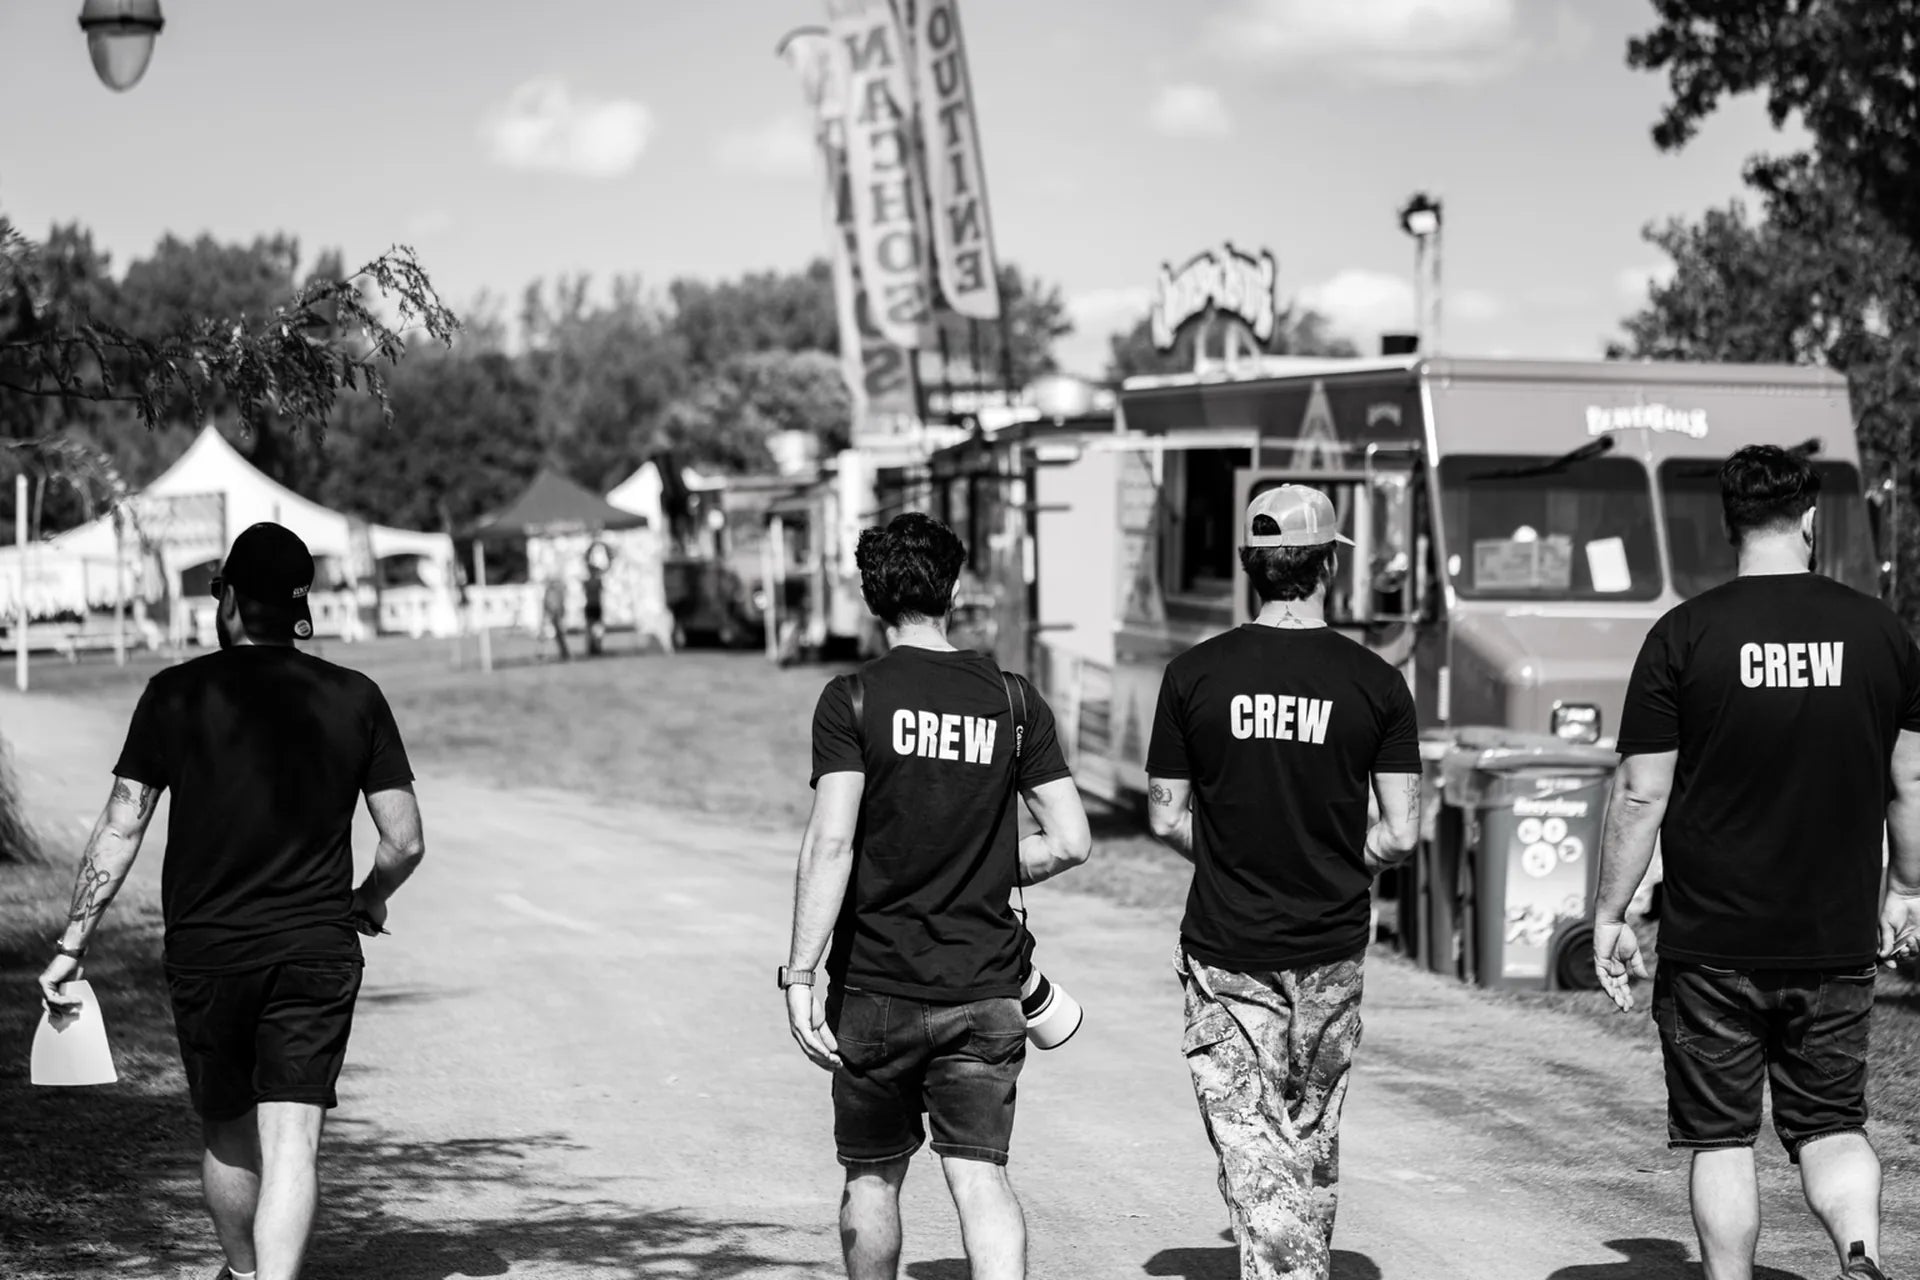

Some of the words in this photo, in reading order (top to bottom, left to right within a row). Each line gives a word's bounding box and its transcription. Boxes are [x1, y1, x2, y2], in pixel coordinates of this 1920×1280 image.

[1740, 641, 1844, 688] CREW
[892, 708, 997, 764] CREW
[1230, 693, 1334, 745] CREW
